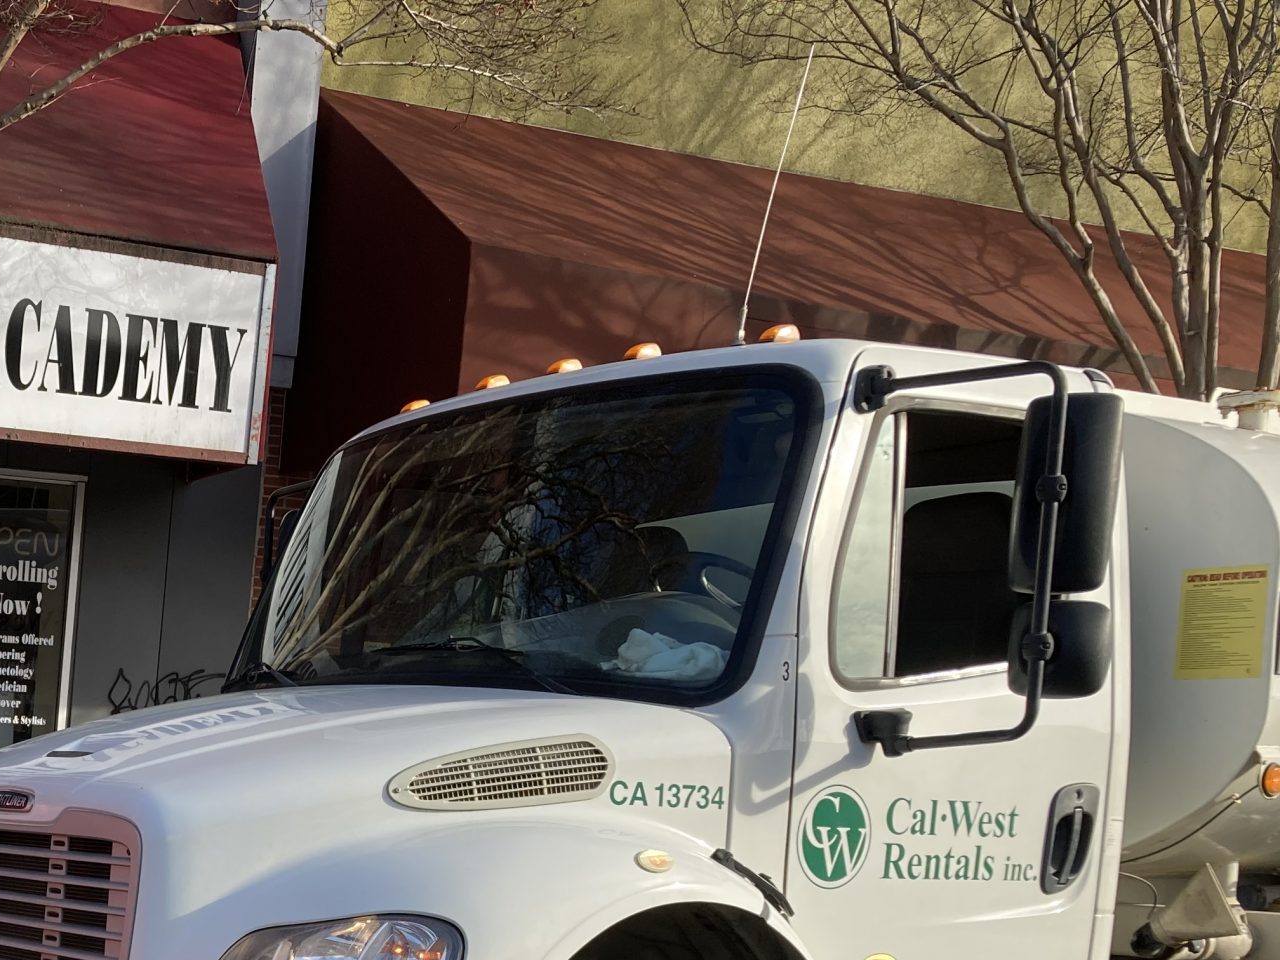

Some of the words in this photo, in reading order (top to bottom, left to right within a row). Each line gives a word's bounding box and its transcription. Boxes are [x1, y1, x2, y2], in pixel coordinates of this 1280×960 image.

[21, 633, 54, 647] Offered
[782, 660, 790, 682] 3
[13, 715, 19, 725] &
[20, 715, 47, 726] Stylists
[609, 780, 648, 806] CA
[654, 783, 725, 809] 13734
[881, 842, 994, 881] Rentals
[1004, 856, 1038, 882] inc.
